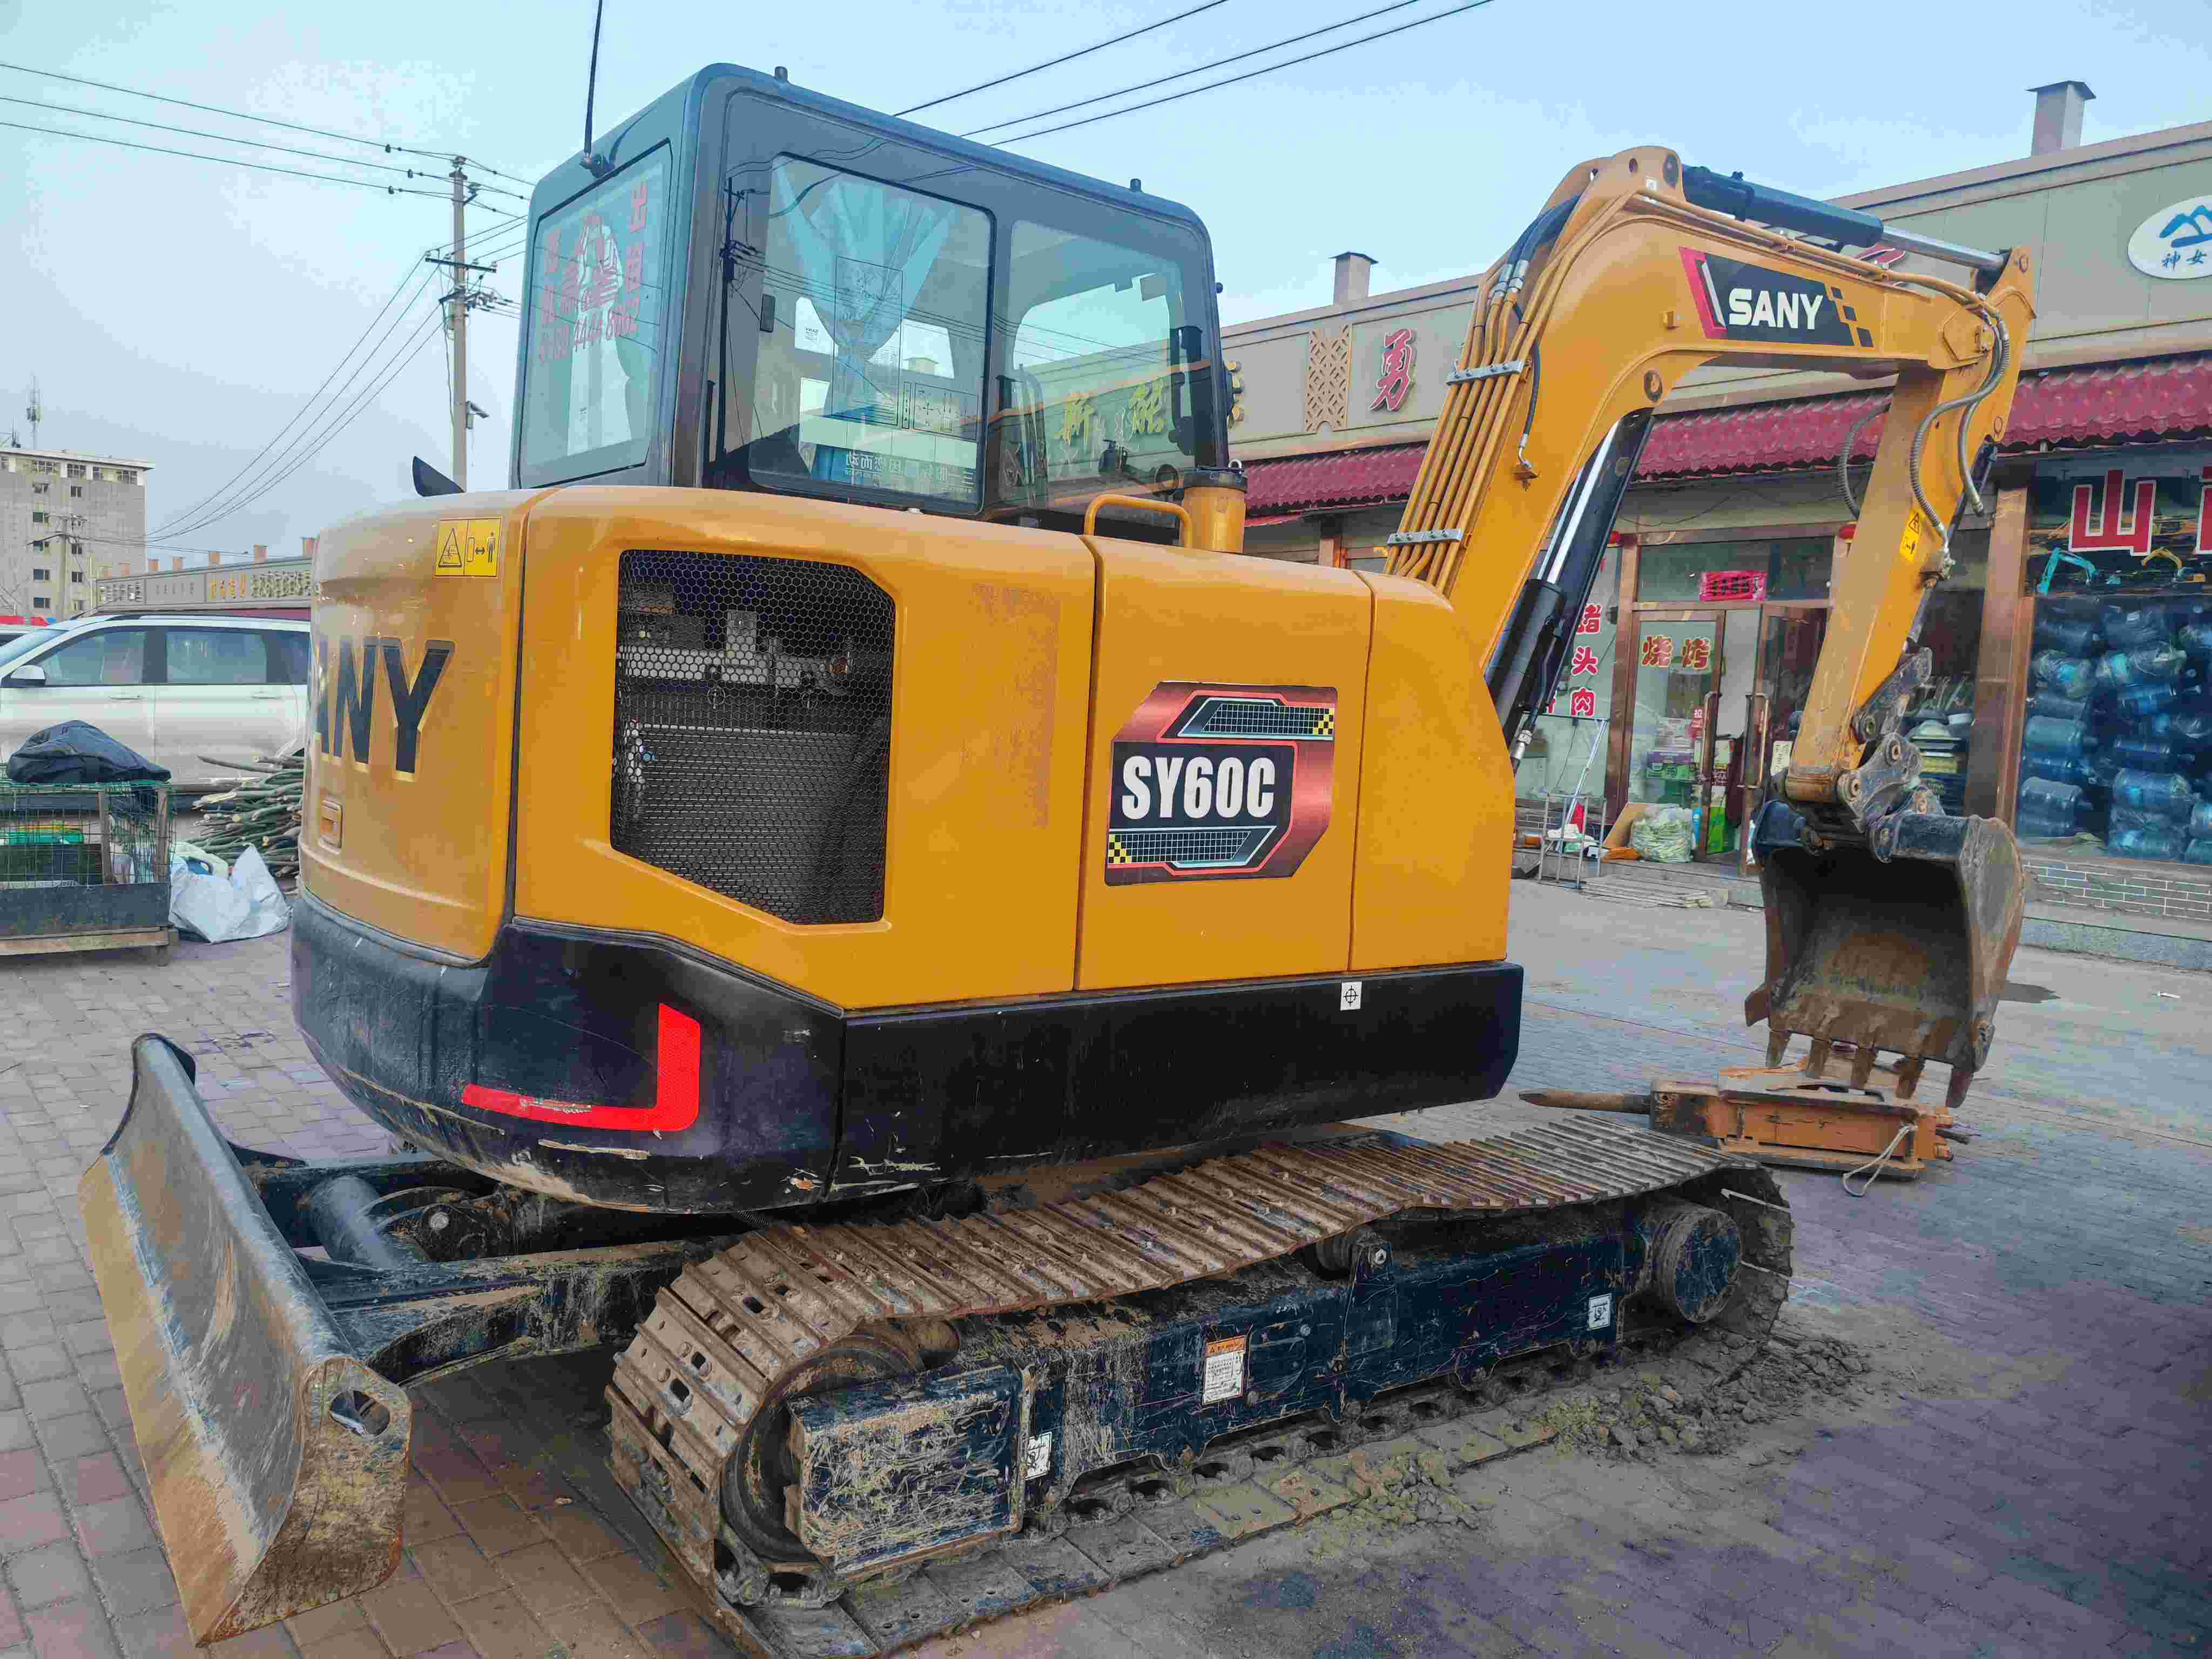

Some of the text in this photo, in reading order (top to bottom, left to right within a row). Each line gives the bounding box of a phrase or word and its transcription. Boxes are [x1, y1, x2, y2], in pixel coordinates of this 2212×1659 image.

[1728, 288, 1824, 330] SANY
[1642, 635, 1711, 670] 烧烤
[1121, 756, 1276, 820] SY60C
